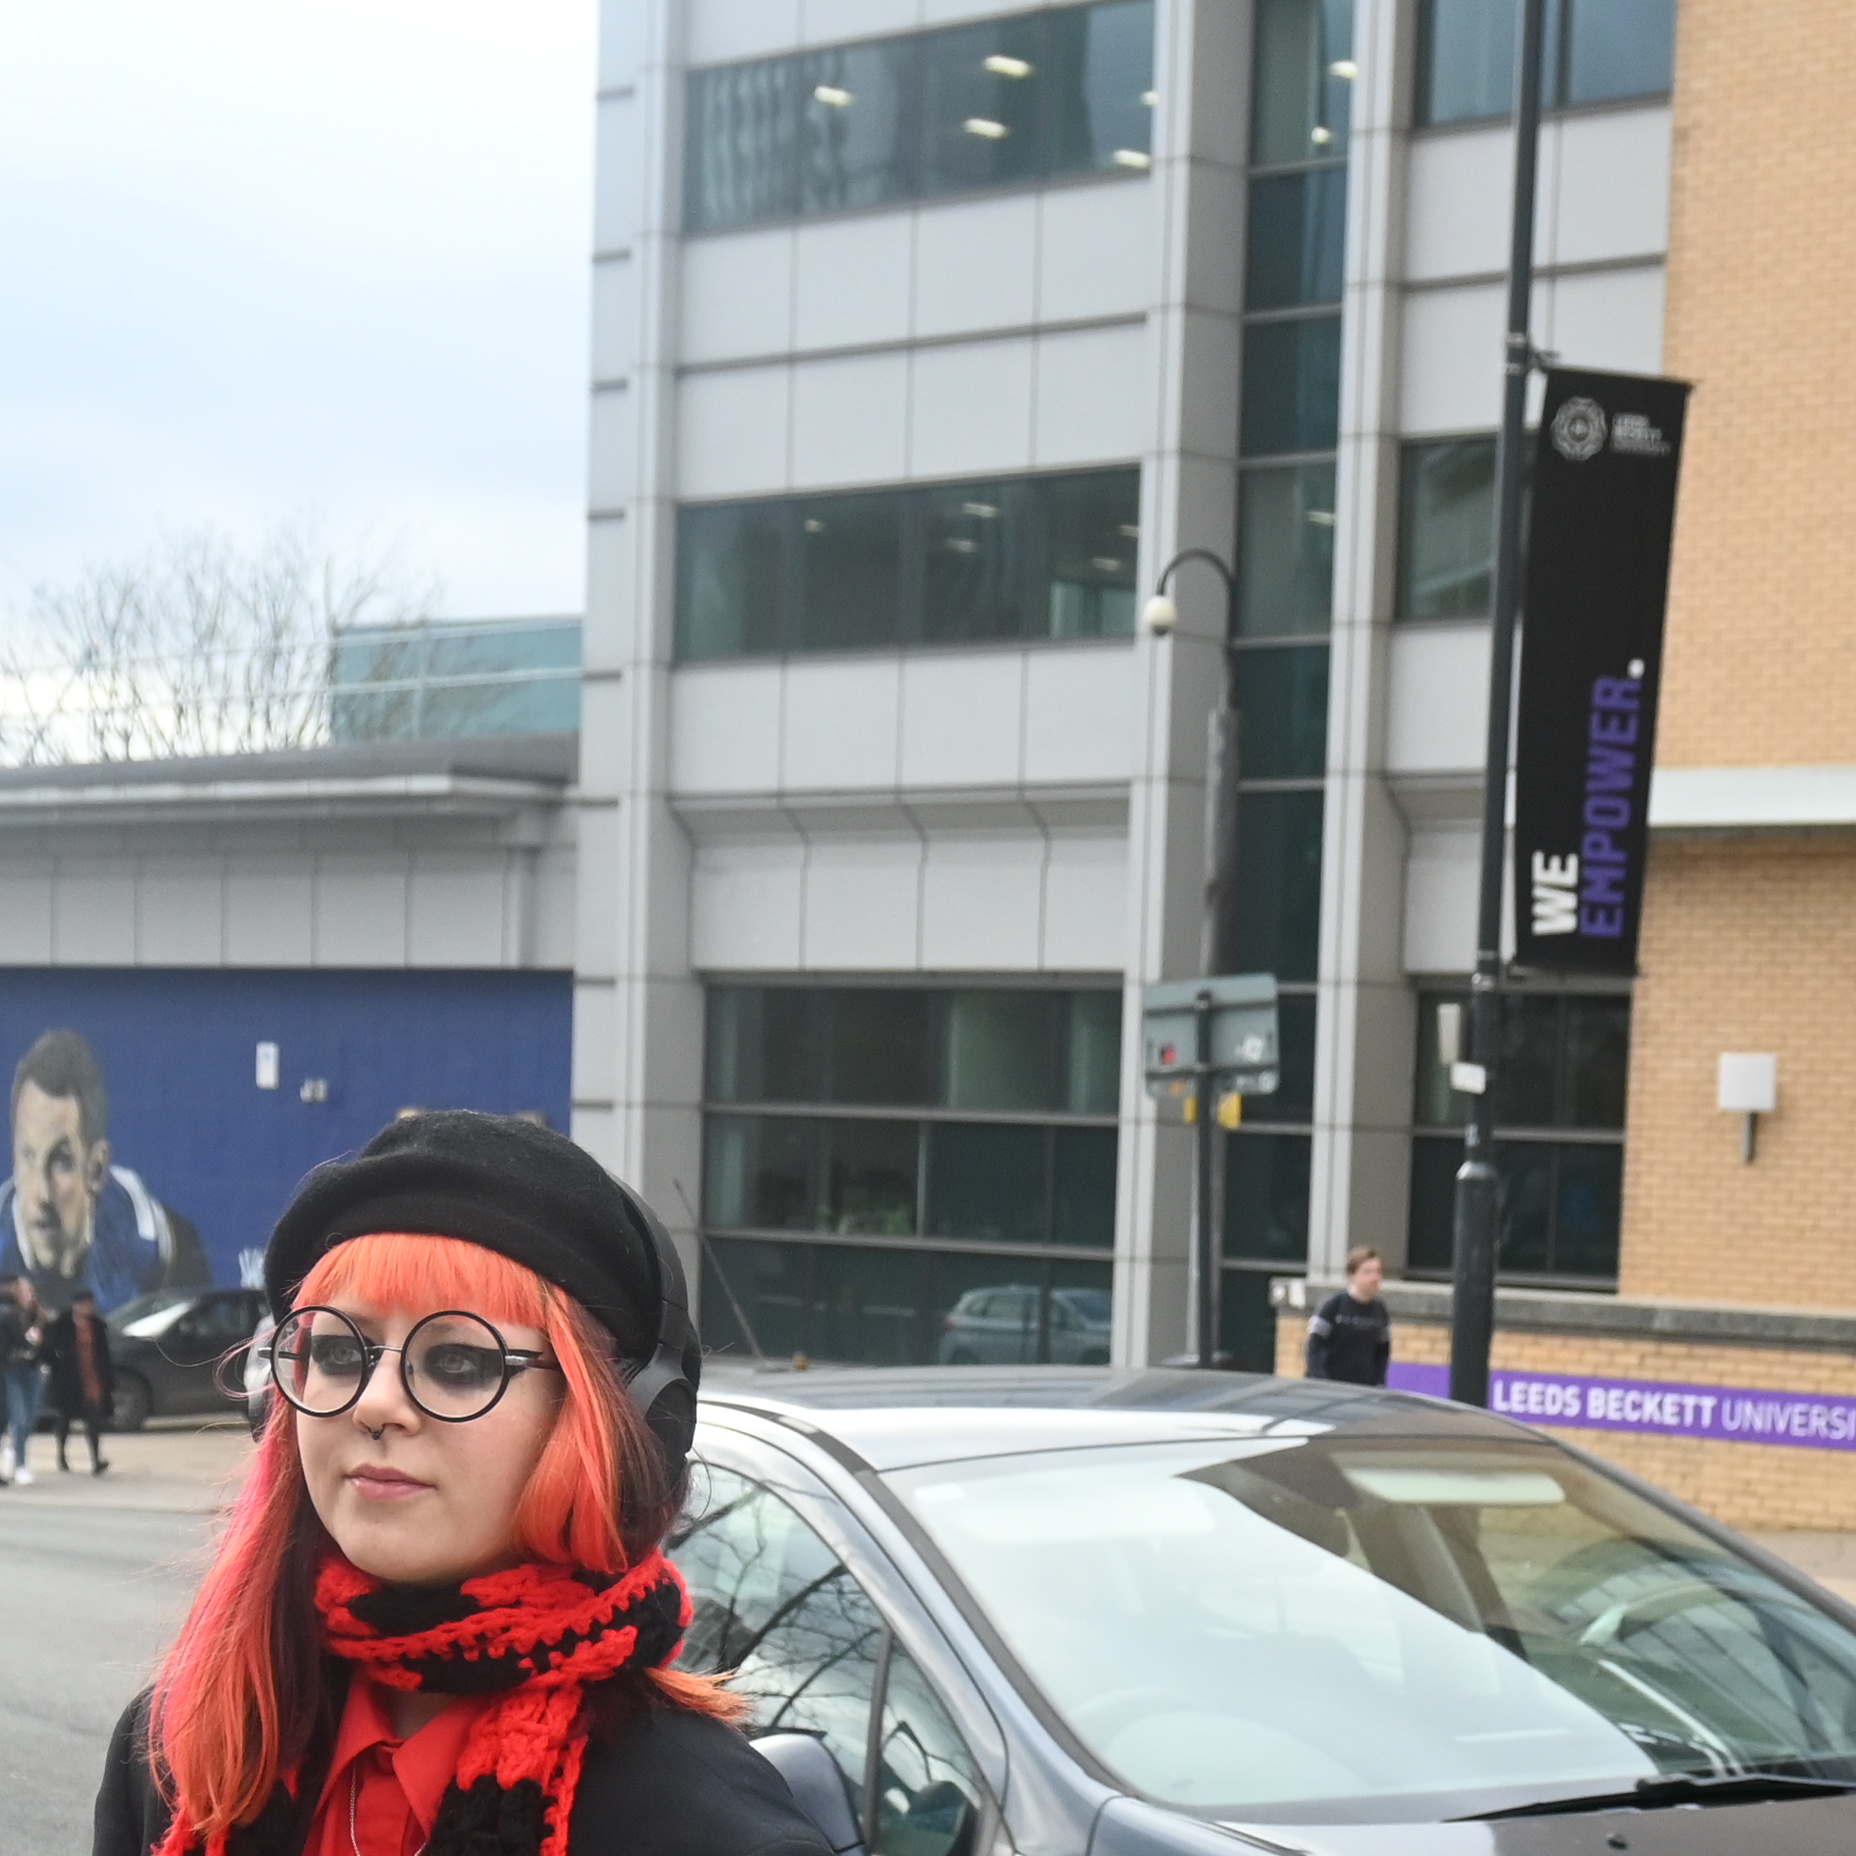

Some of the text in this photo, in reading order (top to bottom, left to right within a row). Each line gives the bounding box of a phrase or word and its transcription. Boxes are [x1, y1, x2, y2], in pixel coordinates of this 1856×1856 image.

[1578, 657, 1645, 939] EMPOWER.
[1532, 851, 1579, 936] WE
[1492, 1379, 1581, 1418] LEEDS
[1586, 1385, 1718, 1429] BECKETT
